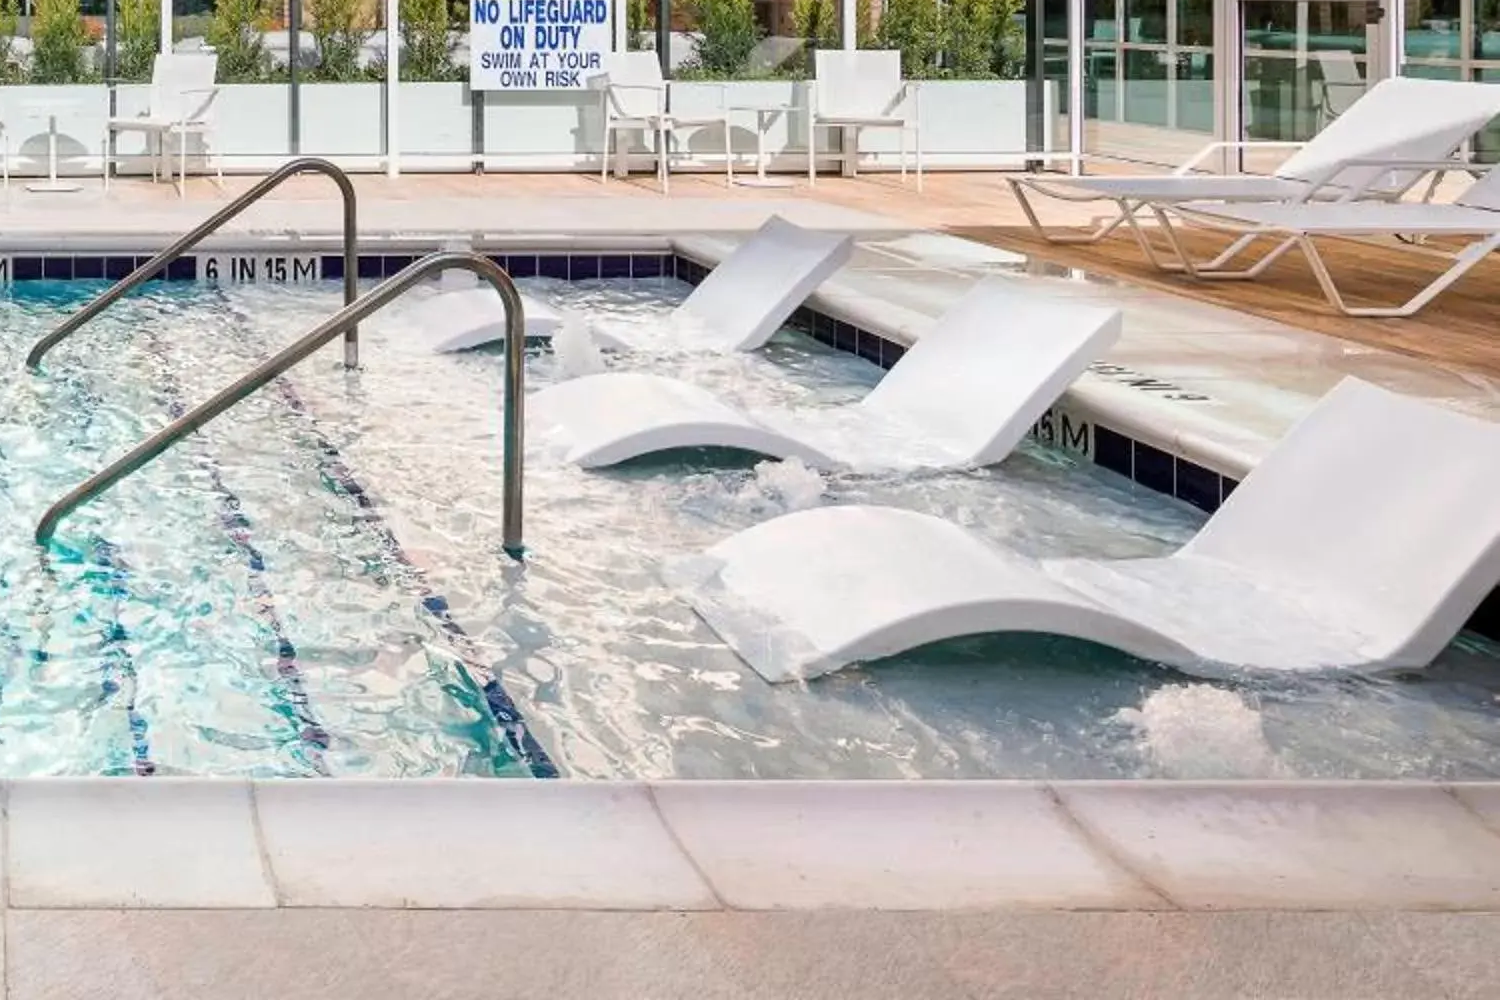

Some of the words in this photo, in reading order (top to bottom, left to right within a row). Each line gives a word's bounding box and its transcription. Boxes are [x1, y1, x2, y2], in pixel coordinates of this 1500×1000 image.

[475, 0, 499, 24] NO
[509, 0, 607, 24] LIFEGUARD
[500, 26, 524, 49] ON
[535, 26, 581, 49] DUTY
[481, 53, 521, 69] SWIM
[530, 53, 548, 68] AT
[557, 53, 600, 69] YOUR
[501, 72, 536, 87] OWN
[546, 72, 580, 87] RISK
[205, 258, 218, 280] 6
[231, 257, 256, 281] IN
